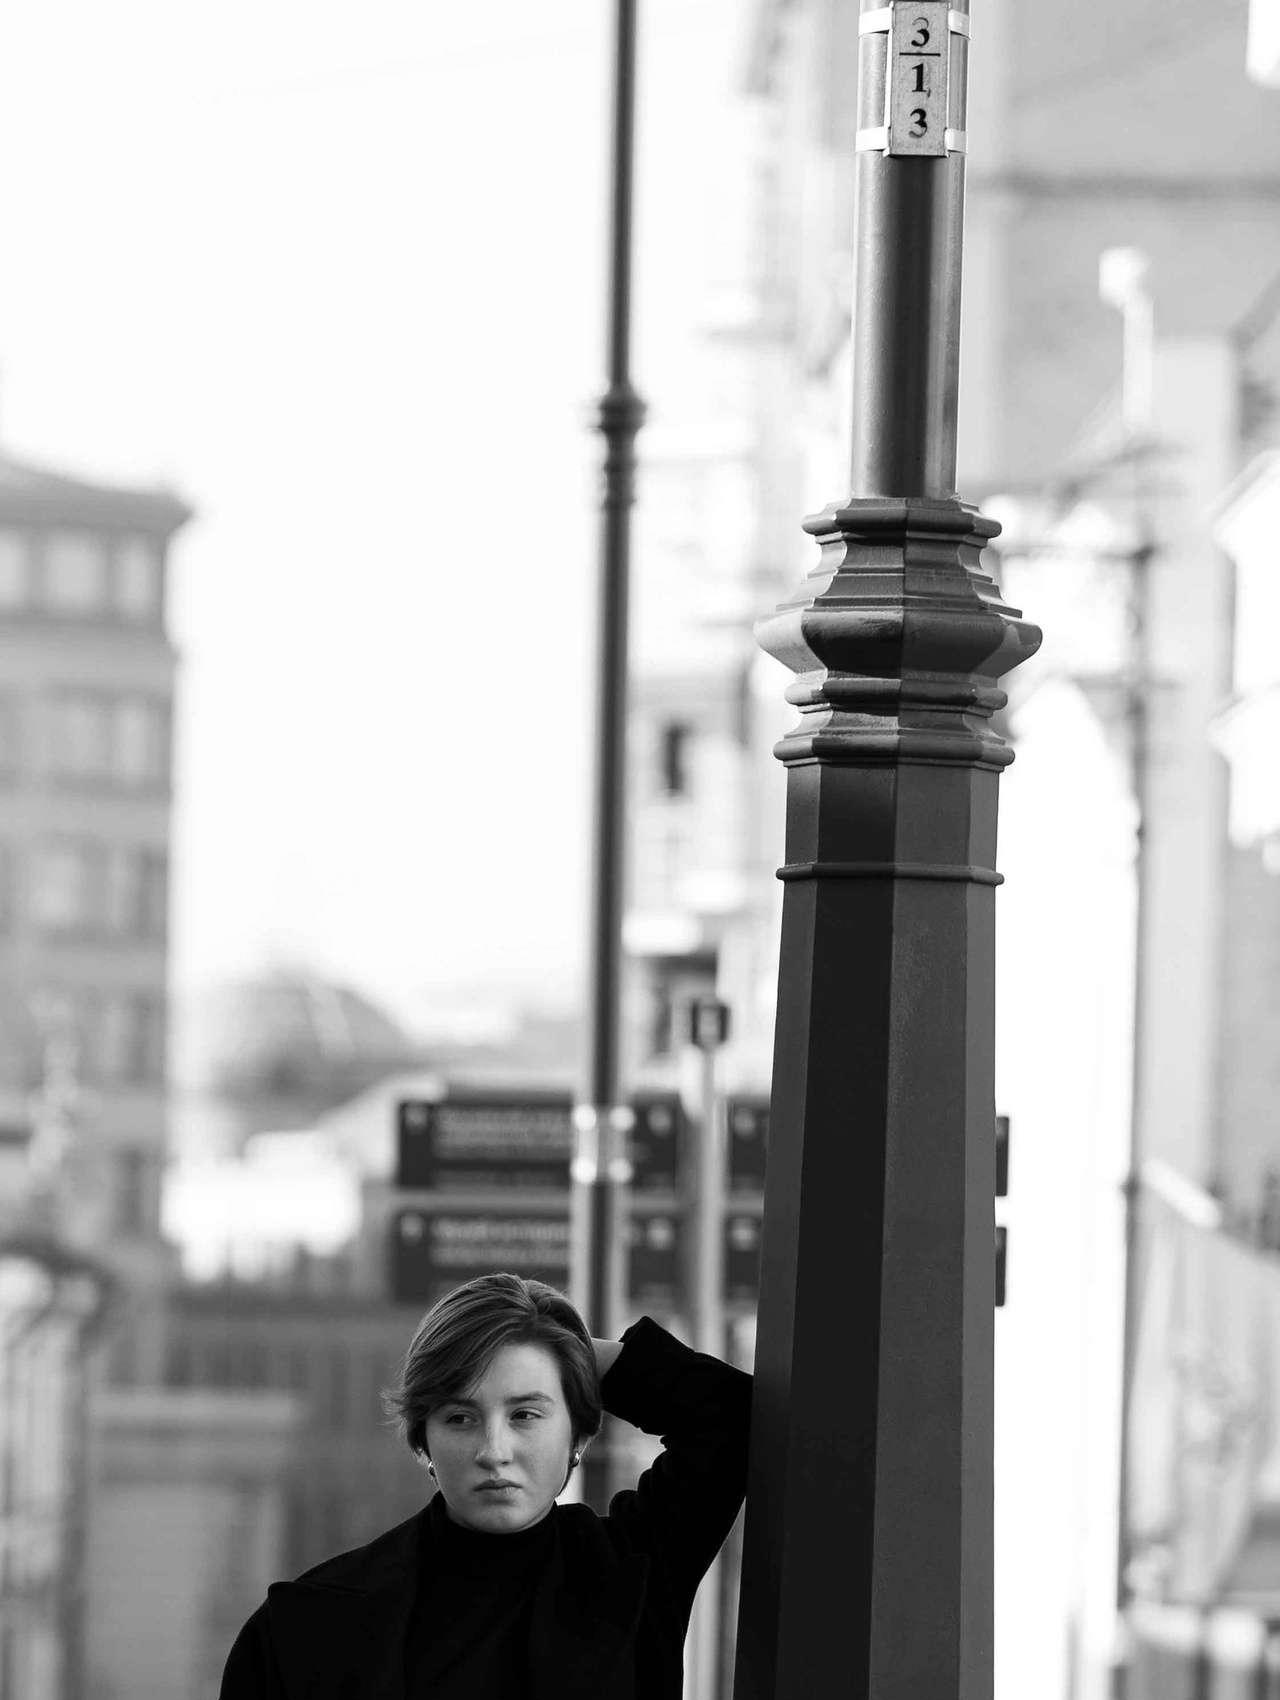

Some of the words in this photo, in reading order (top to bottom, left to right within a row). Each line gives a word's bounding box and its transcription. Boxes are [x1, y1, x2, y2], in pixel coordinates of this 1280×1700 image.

[910, 16, 931, 48] 3
[911, 62, 928, 93] 1
[908, 107, 928, 139] 3
